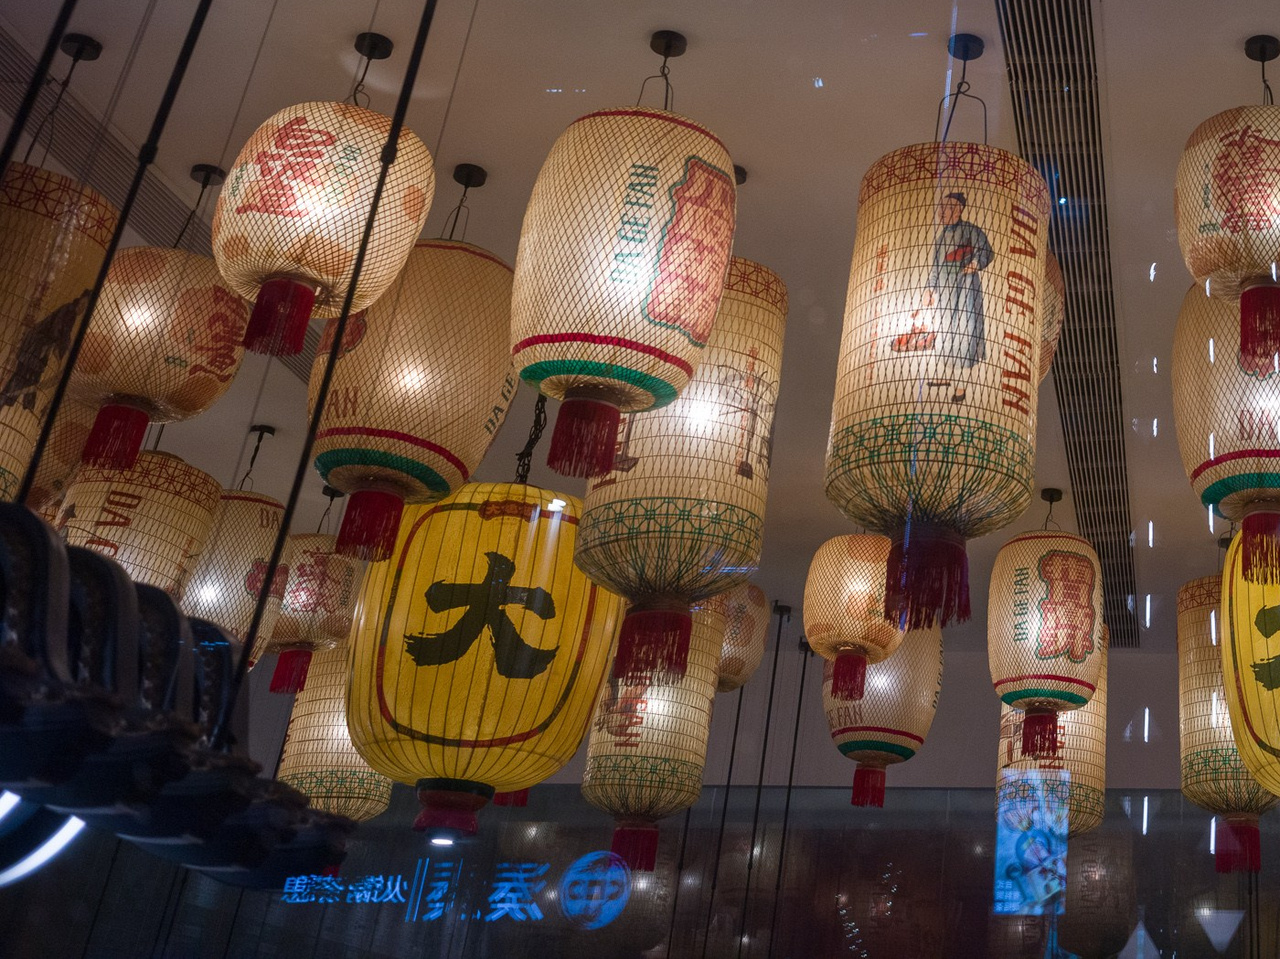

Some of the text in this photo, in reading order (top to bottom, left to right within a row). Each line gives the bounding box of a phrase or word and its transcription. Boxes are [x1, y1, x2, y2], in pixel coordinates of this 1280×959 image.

[625, 163, 659, 209] FAN
[1001, 203, 1039, 416] DA GE FAN
[1239, 409, 1276, 442] DA
[95, 490, 142, 527] DA
[1014, 567, 1029, 595] FAN
[404, 551, 559, 680] 大
[1014, 619, 1028, 642] DA
